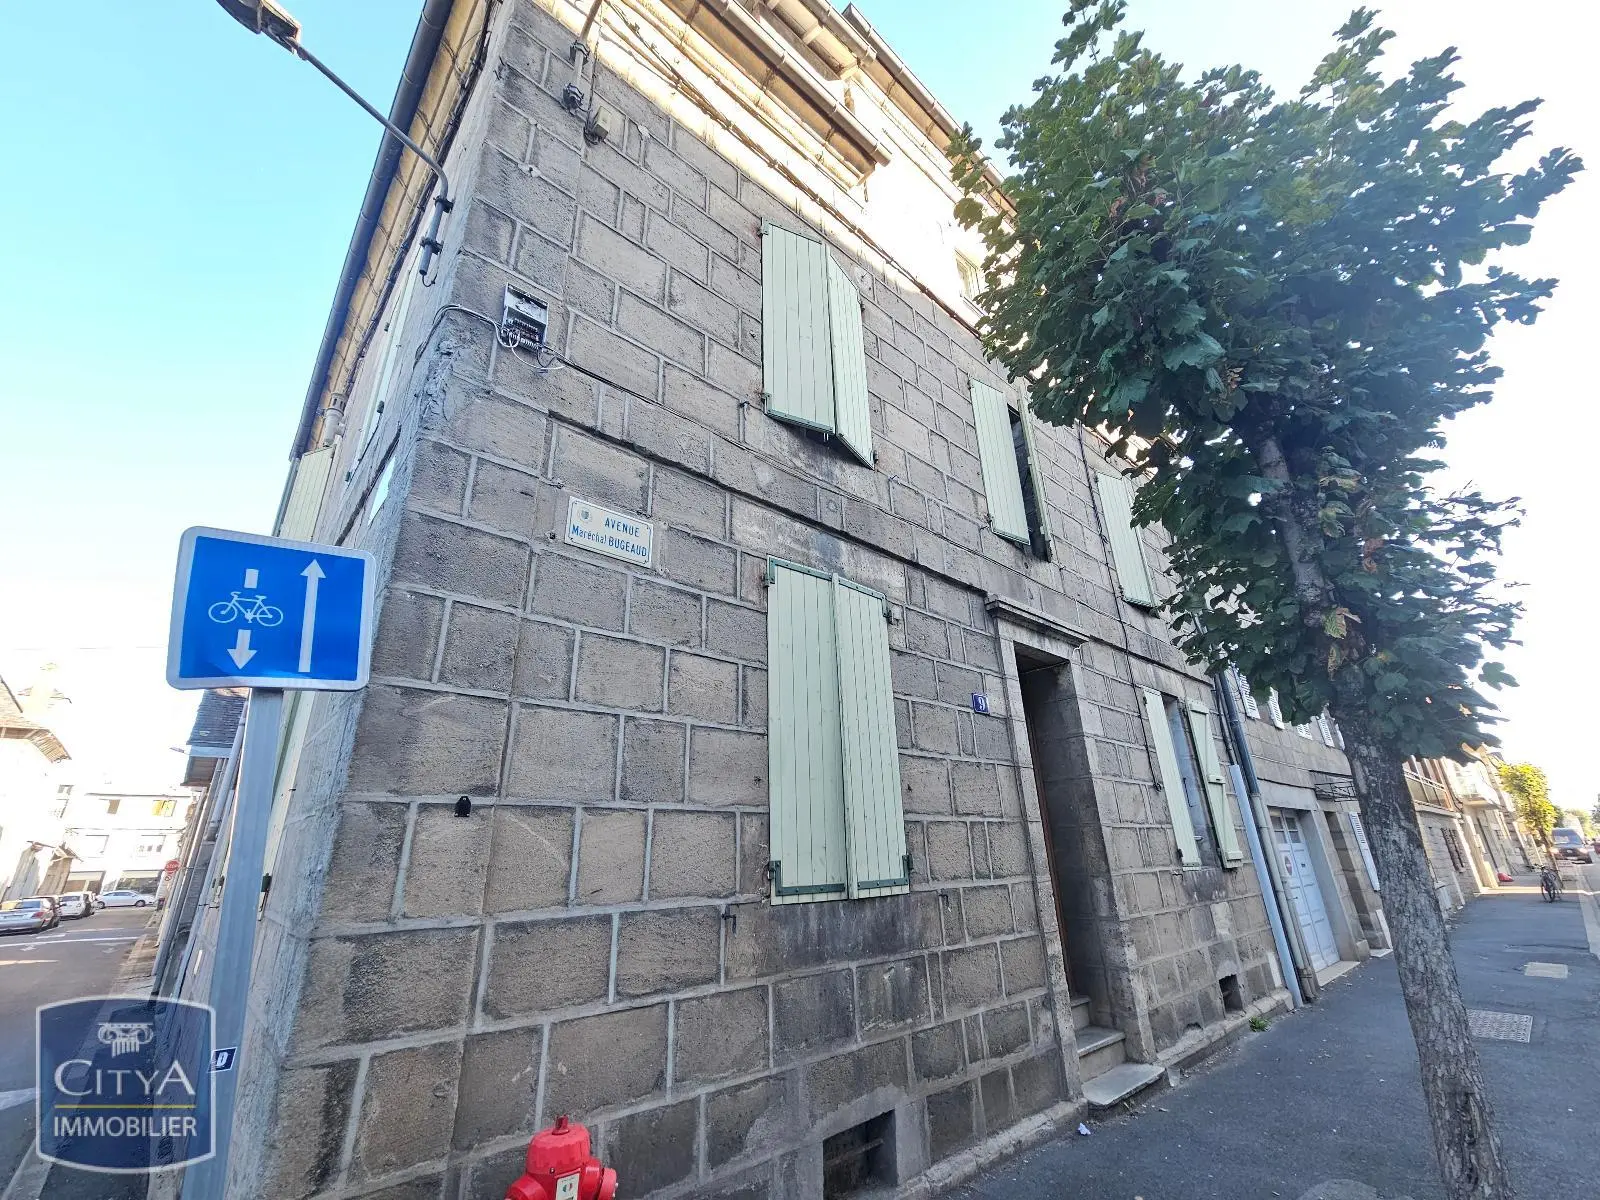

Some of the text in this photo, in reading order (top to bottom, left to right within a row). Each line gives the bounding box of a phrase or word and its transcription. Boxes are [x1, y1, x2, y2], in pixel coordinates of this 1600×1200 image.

[604, 517, 640, 538] AVENUE
[571, 524, 647, 557] Maréchal BUGEAUD
[977, 696, 986, 711] 9
